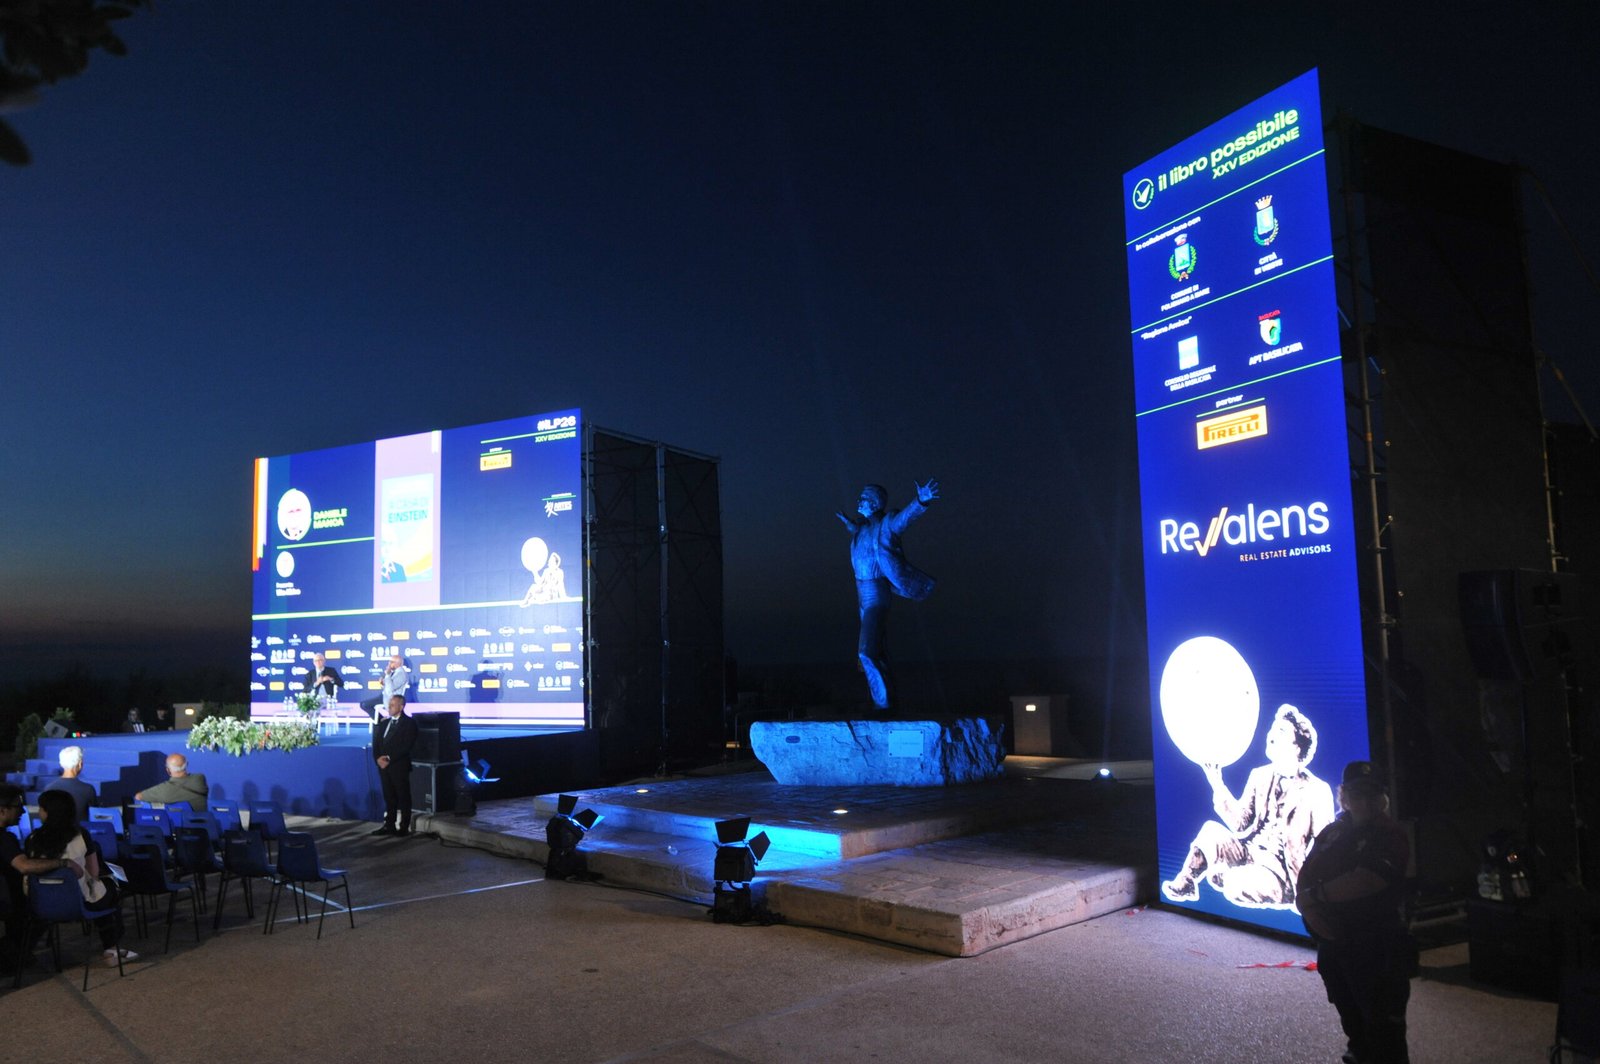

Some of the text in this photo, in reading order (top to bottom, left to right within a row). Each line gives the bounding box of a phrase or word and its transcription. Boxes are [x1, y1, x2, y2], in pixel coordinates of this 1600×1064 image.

[1158, 109, 1299, 191] il libro possibile
[1212, 126, 1300, 180] XXV EDIZIONE
[1203, 413, 1260, 443] PIRELLI
[1239, 544, 1332, 562] REAL ESTATE ADVISORS
